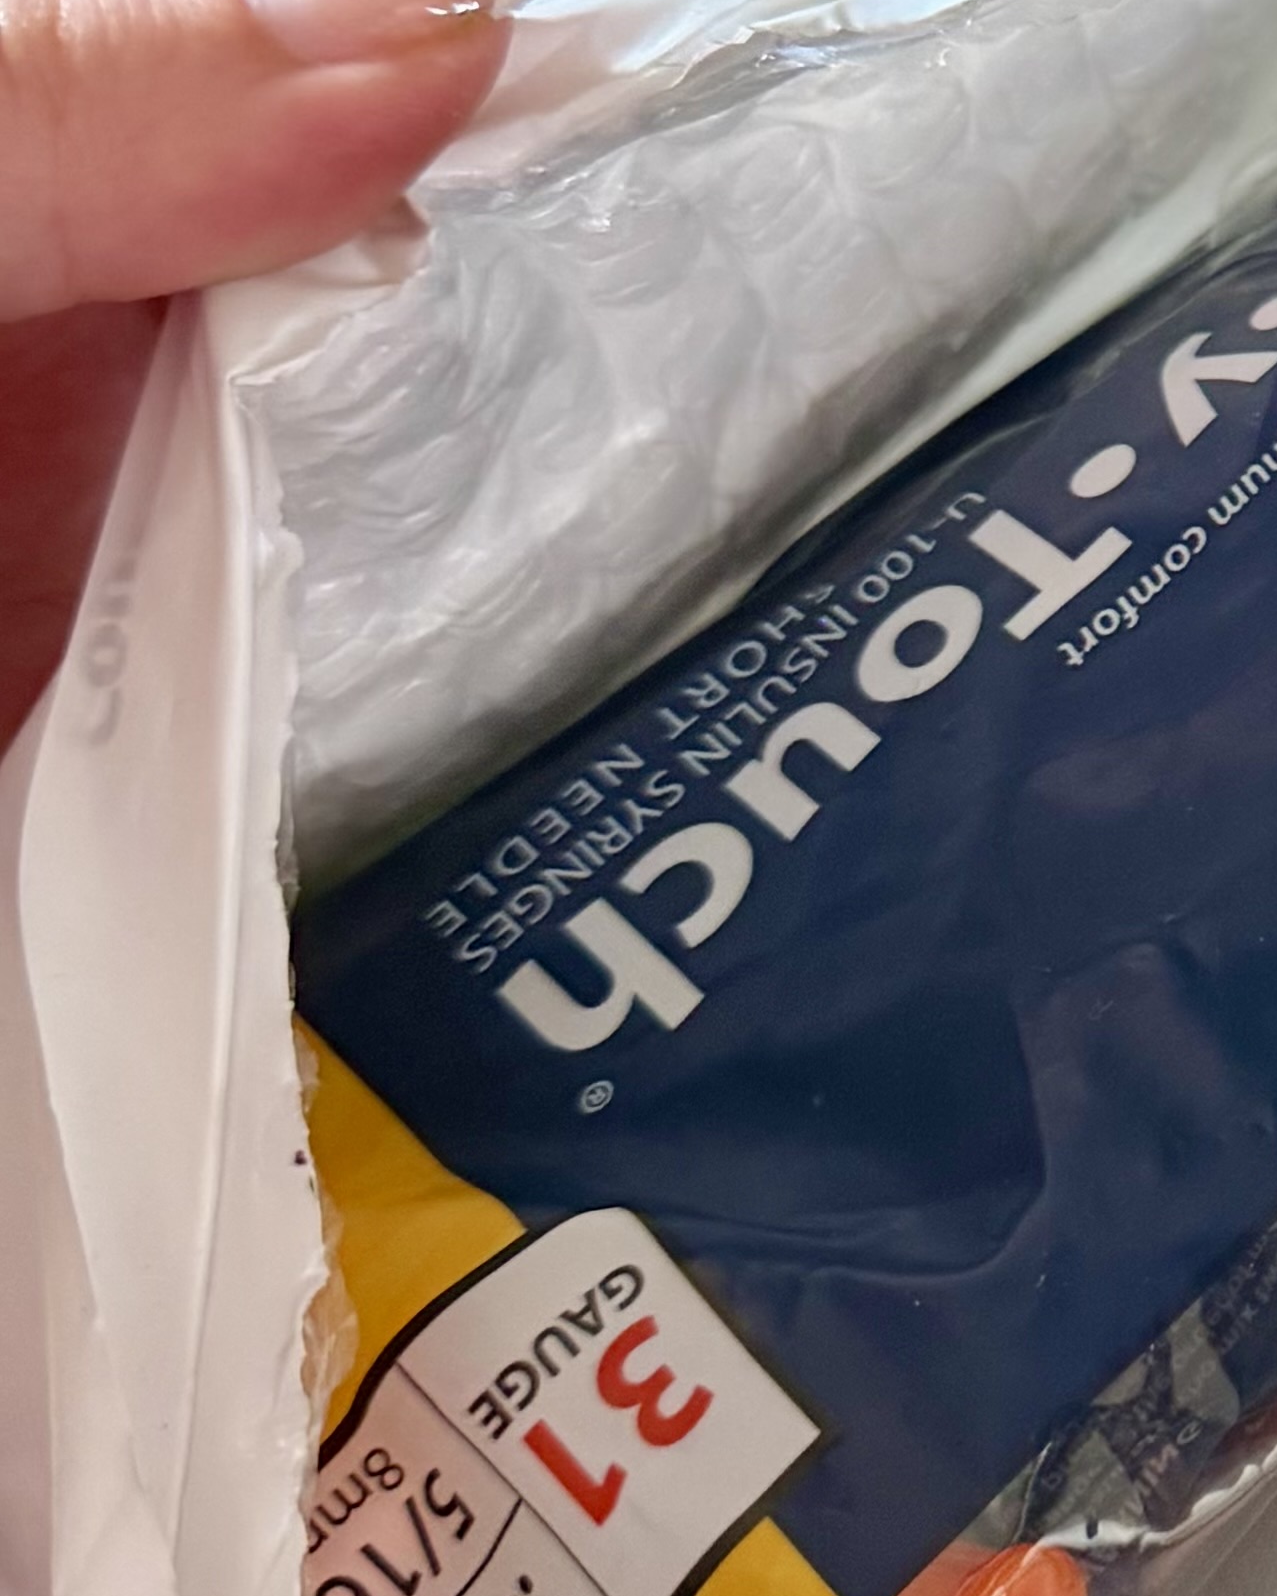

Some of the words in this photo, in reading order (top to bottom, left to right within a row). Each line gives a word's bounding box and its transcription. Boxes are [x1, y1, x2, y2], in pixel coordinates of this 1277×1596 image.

[856, 492, 987, 603] U-100
[1056, 525, 1208, 667] comfort
[657, 583, 836, 741] SHORT
[678, 604, 860, 776] INSULIN
[424, 743, 646, 938] NEEDLE
[497, 507, 1133, 1051] Touch
[457, 768, 686, 974] SYRINGES
[466, 1263, 647, 1441] GAUGE
[521, 1313, 716, 1529] 31
